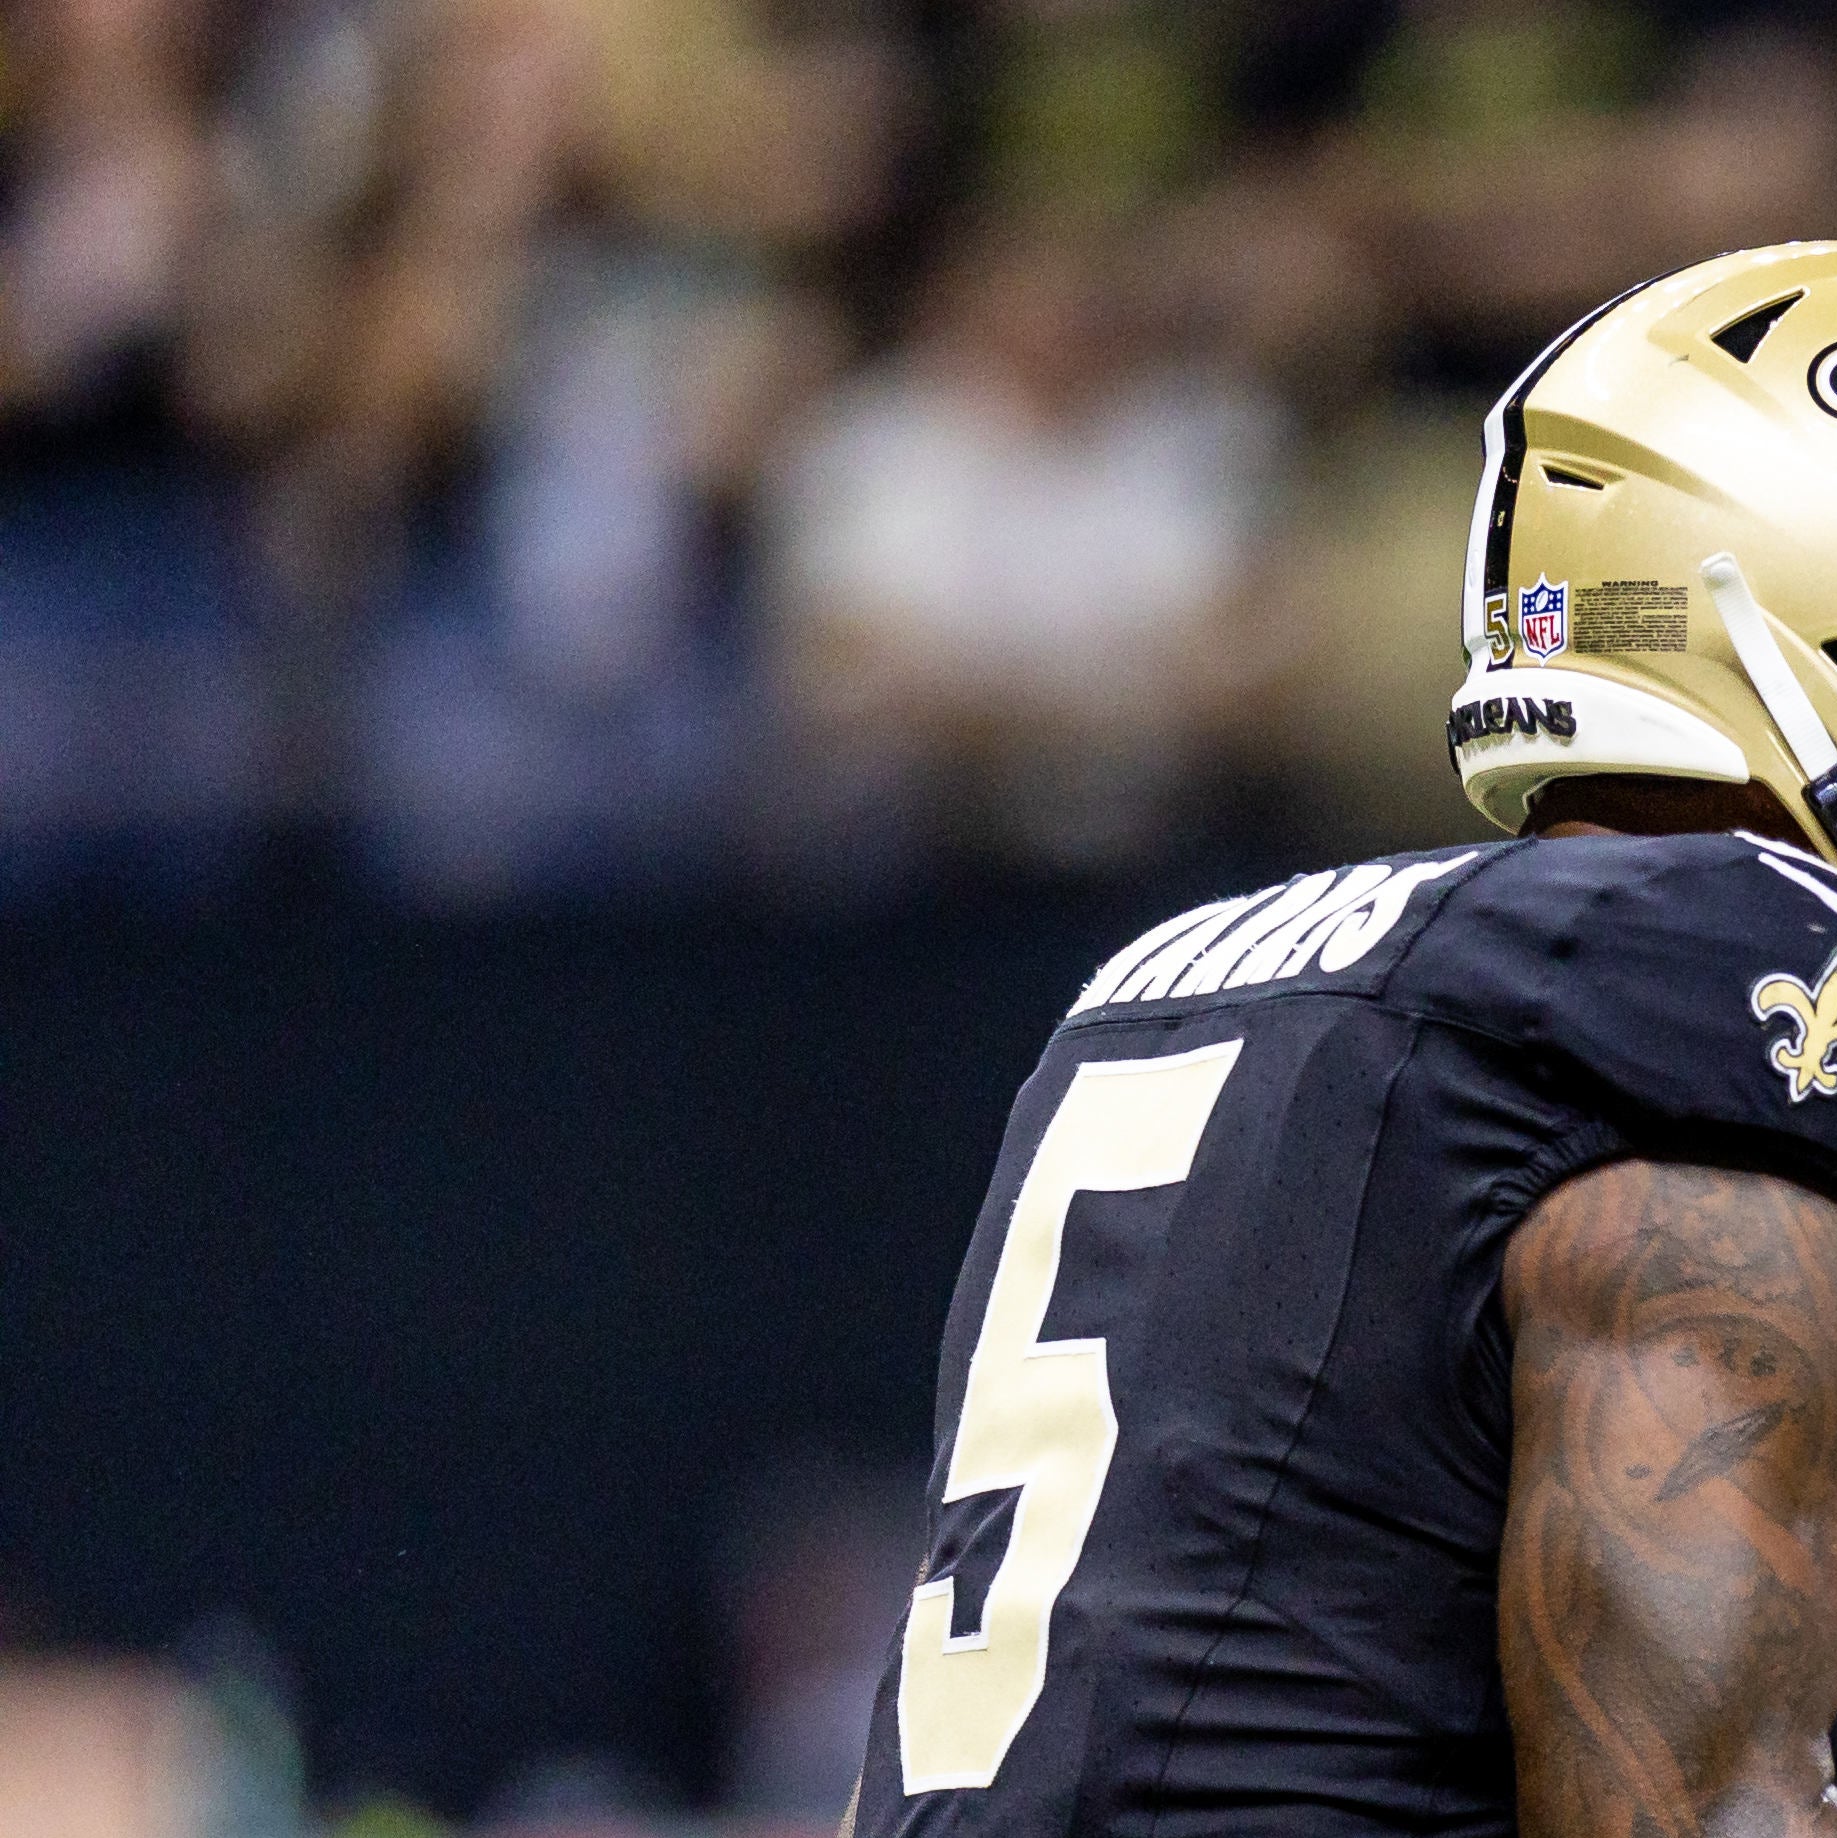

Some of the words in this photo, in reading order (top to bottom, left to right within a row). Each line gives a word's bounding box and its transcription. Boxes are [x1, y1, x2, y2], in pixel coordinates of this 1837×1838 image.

[1485, 592, 1515, 666] 5
[1525, 614, 1560, 651] NFL
[898, 1037, 1245, 1798] 5
